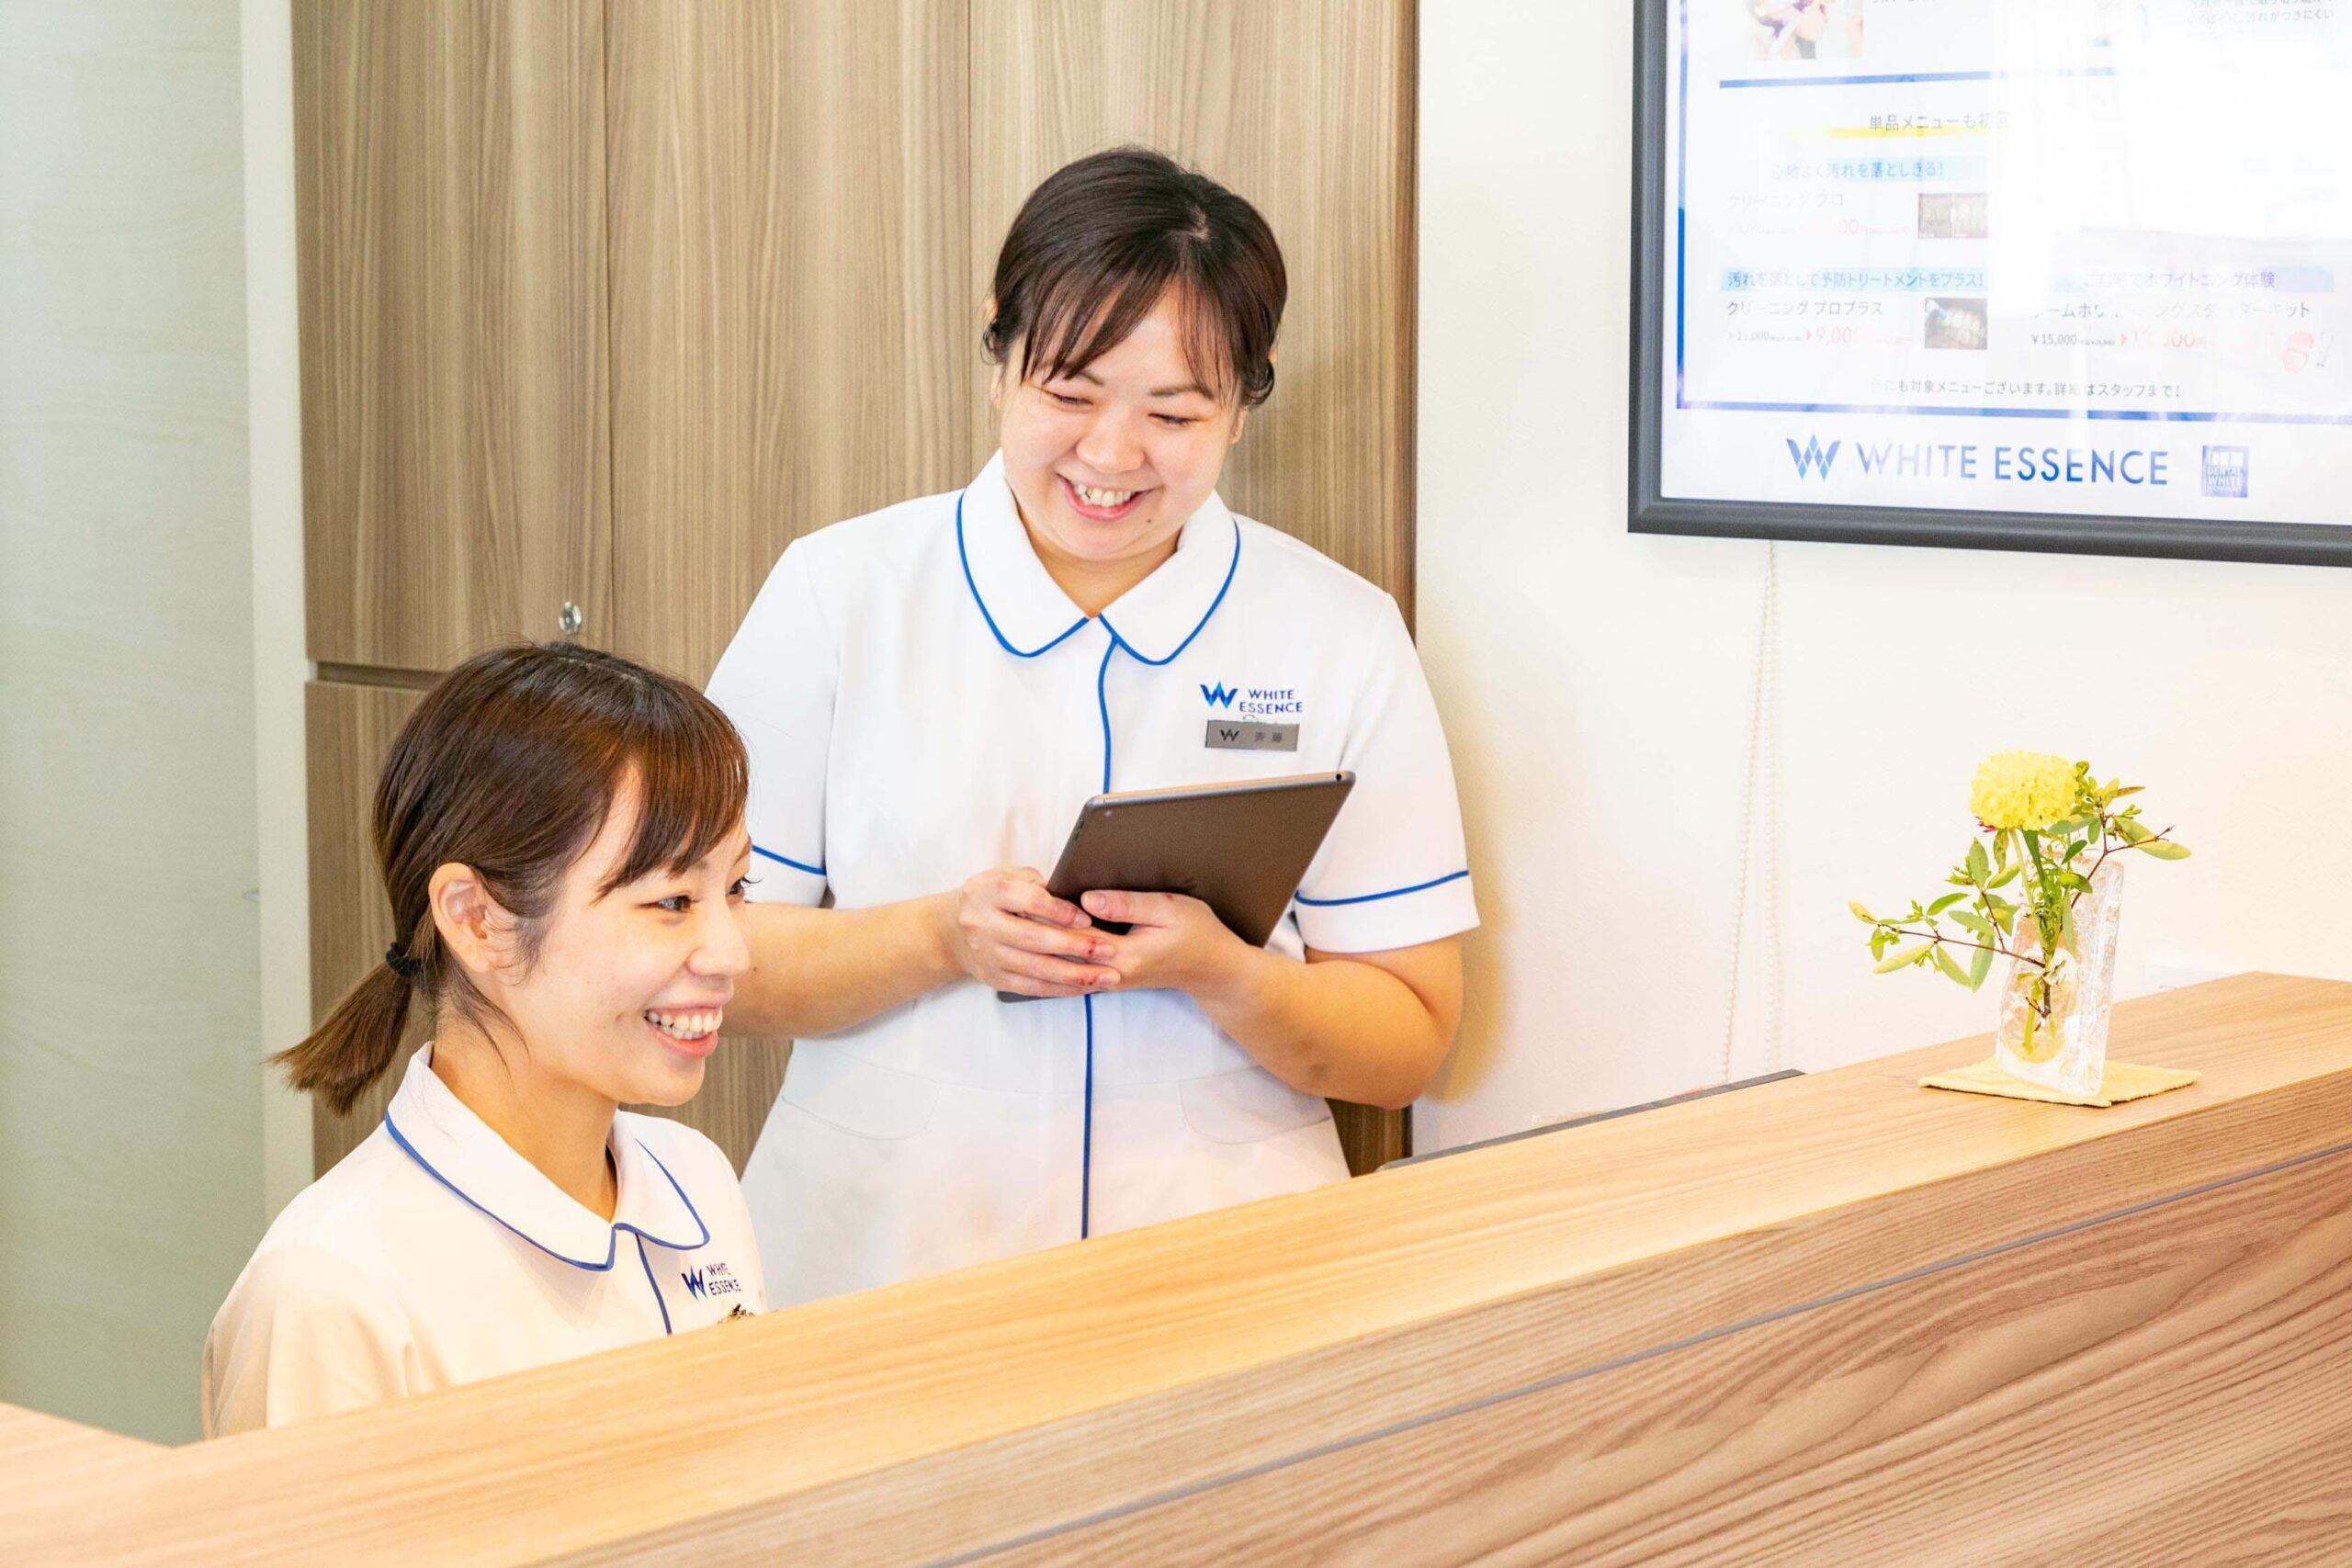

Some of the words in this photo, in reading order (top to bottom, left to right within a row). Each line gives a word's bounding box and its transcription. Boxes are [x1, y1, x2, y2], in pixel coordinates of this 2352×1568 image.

[1855, 441, 1977, 480] WHITE
[1994, 446, 2168, 486] ESSENCE
[1248, 689, 1295, 701] WHITE
[1239, 702, 1304, 715] ESSENCE
